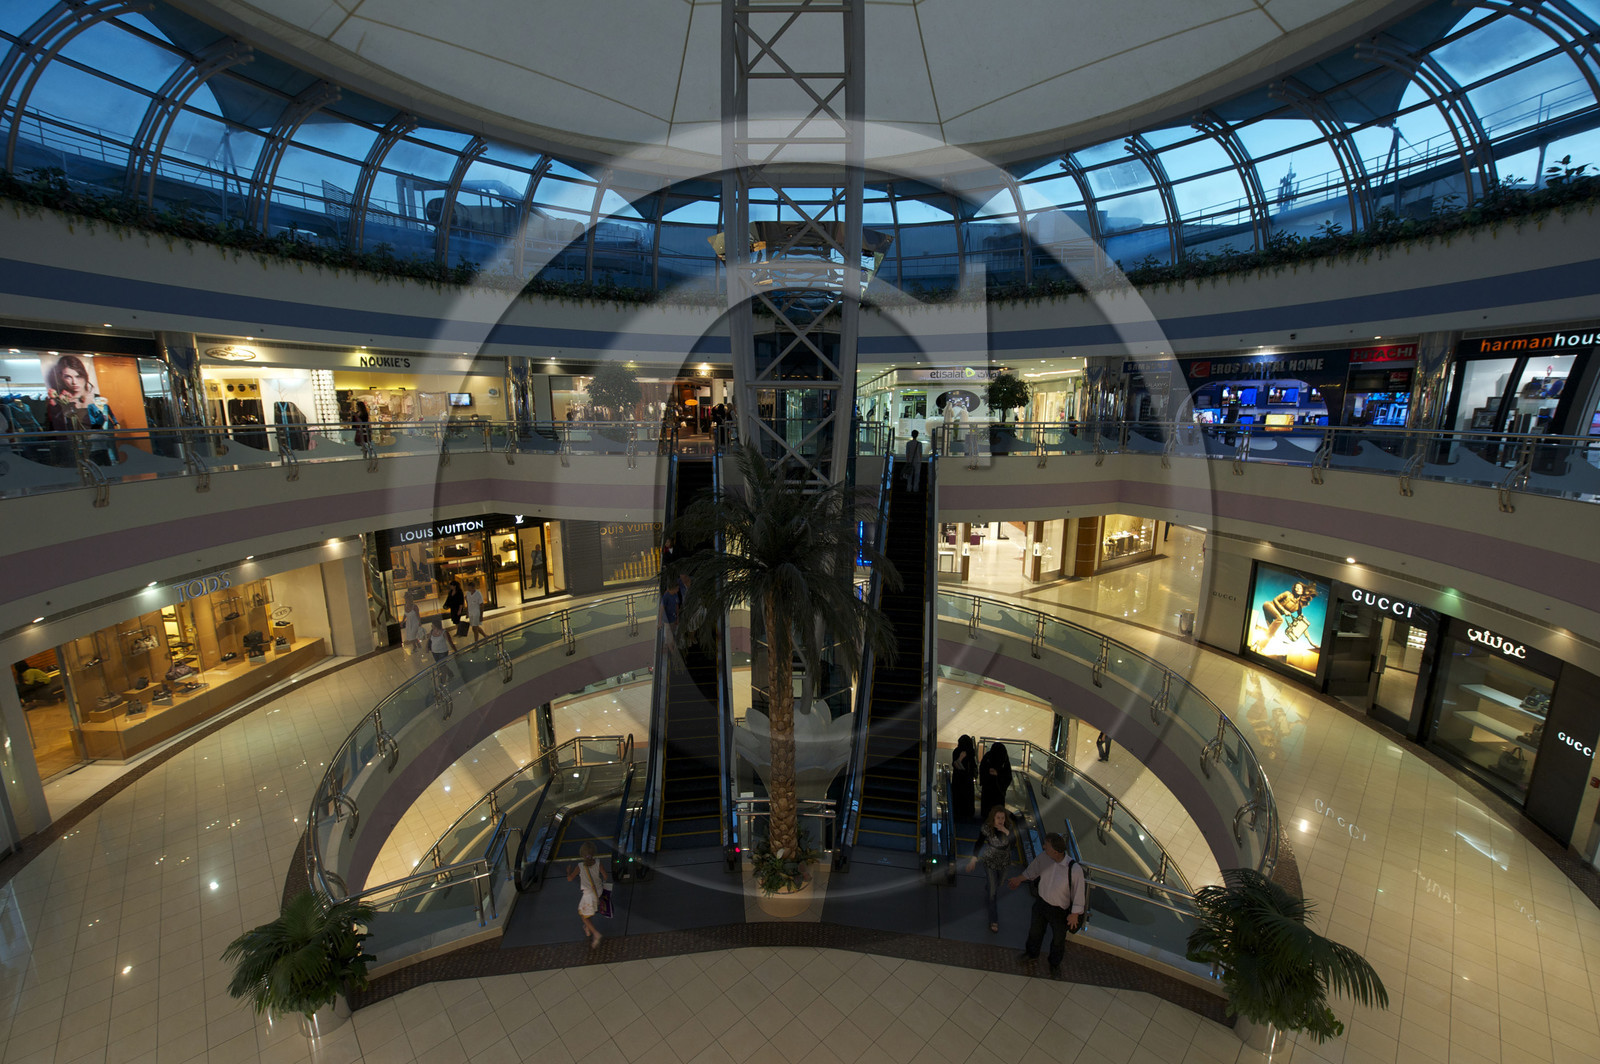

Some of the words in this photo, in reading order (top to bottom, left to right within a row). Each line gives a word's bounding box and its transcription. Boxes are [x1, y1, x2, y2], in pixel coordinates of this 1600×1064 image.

[1353, 346, 1414, 360] HITACHI
[360, 356, 411, 368] NOUKIE'S
[1210, 363, 1241, 375] EROS
[1241, 361, 1286, 374] DIGITAL
[1289, 358, 1324, 371] HOME
[929, 370, 964, 379] etisalat
[400, 527, 434, 542] LOUIS
[437, 520, 484, 535] VUITTON
[627, 522, 663, 532] VUITTO
[1212, 591, 1237, 601] GUCCI
[1352, 589, 1413, 619] GUCCI
[1558, 731, 1596, 760] GUCCI
